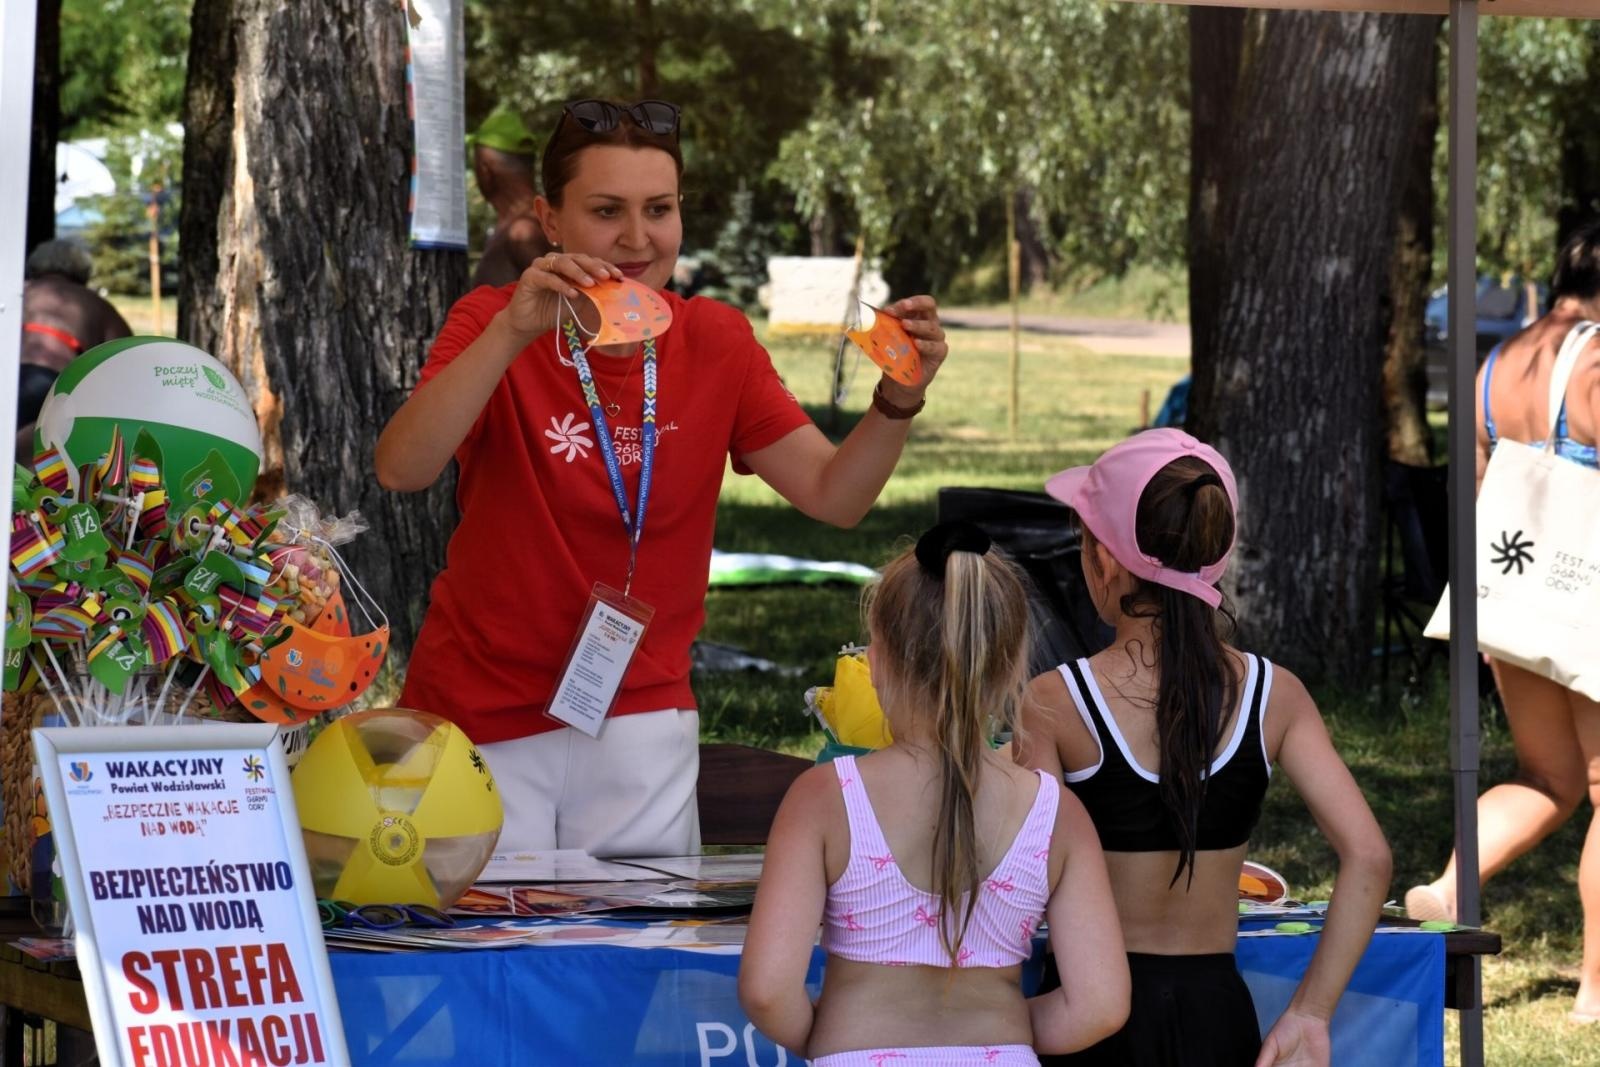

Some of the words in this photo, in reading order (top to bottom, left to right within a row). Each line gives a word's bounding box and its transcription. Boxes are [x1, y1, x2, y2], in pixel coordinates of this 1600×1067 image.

[154, 364, 199, 379] Poczuj
[162, 377, 196, 388] miętę
[105, 757, 224, 779] WAKACYJNY
[111, 782, 149, 794] Powiat
[151, 779, 226, 793] Wodzisławski
[184, 799, 240, 815] WAKACJE
[140, 821, 166, 837] NAD
[90, 859, 294, 901] BEZPIECZEŃSTWO
[137, 904, 188, 935] NAD
[189, 899, 265, 933] WODĄ
[122, 943, 304, 1015] STREFA
[127, 1013, 326, 1067] EDUKACJI
